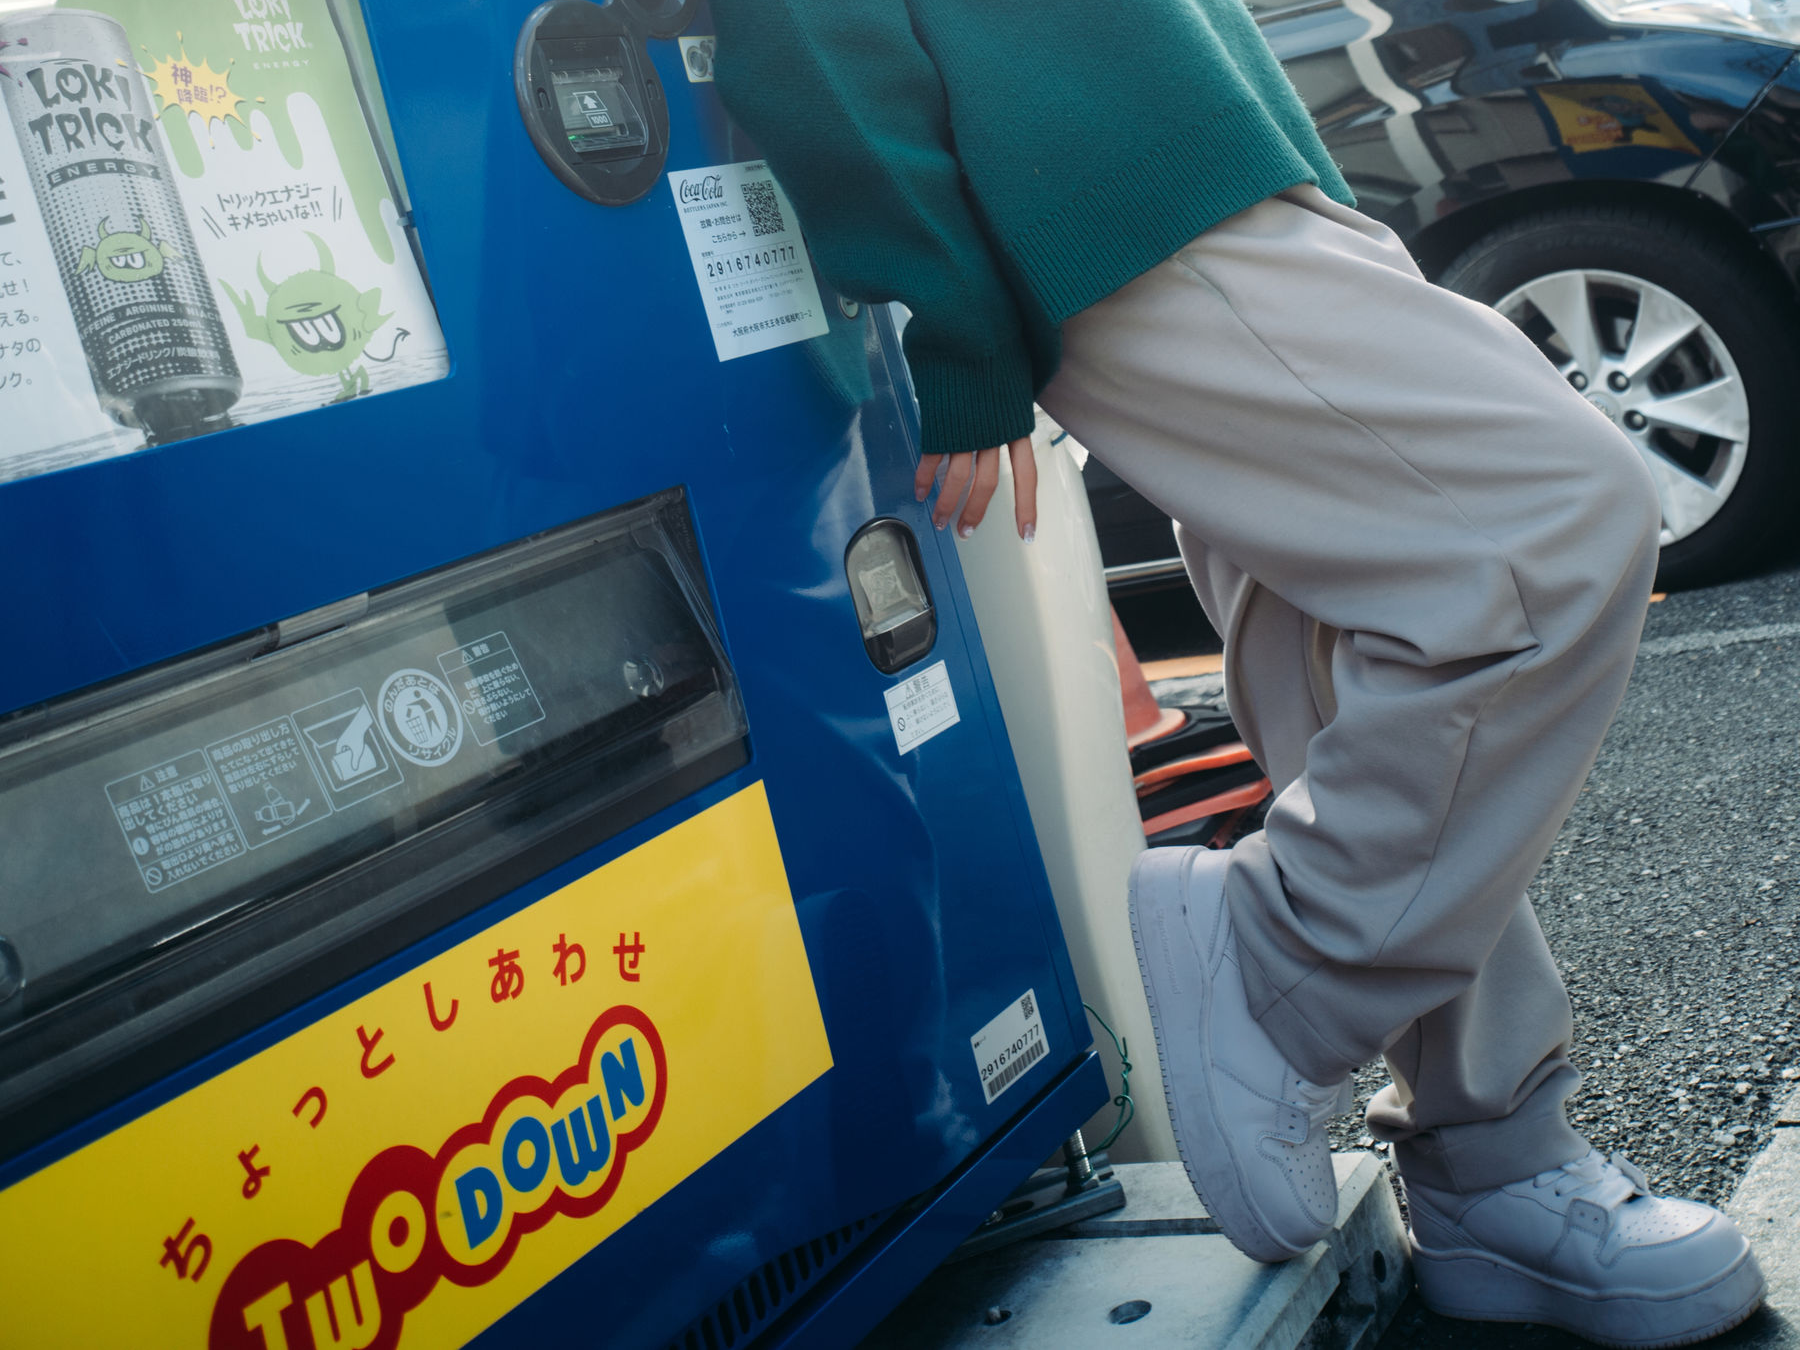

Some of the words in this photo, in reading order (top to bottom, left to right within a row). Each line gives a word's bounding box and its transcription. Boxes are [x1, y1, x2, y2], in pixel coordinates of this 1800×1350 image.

[232, 20, 307, 54] TRICK
[171, 62, 193, 87] 神
[252, 58, 310, 71] ENERGY
[25, 62, 133, 113] LOKI
[27, 106, 156, 156] TRICK
[50, 162, 157, 185] ENERGY
[216, 182, 323, 213] トリックエナジー
[706, 244, 797, 278] 2916740777
[125, 303, 176, 317] ARGININE
[107, 318, 170, 345] CARBONATED
[384, 674, 441, 713] のんだあとは
[483, 709, 508, 725] ください
[408, 726, 457, 761] リサイクル
[227, 760, 297, 794] 取り出してください
[122, 793, 199, 832] 出してください
[980, 1023, 1041, 1082] 2916740777
[159, 930, 646, 1284] ちょっとしあわせ
[243, 1190, 427, 1350] TWO
[454, 1036, 646, 1251] DOWN
